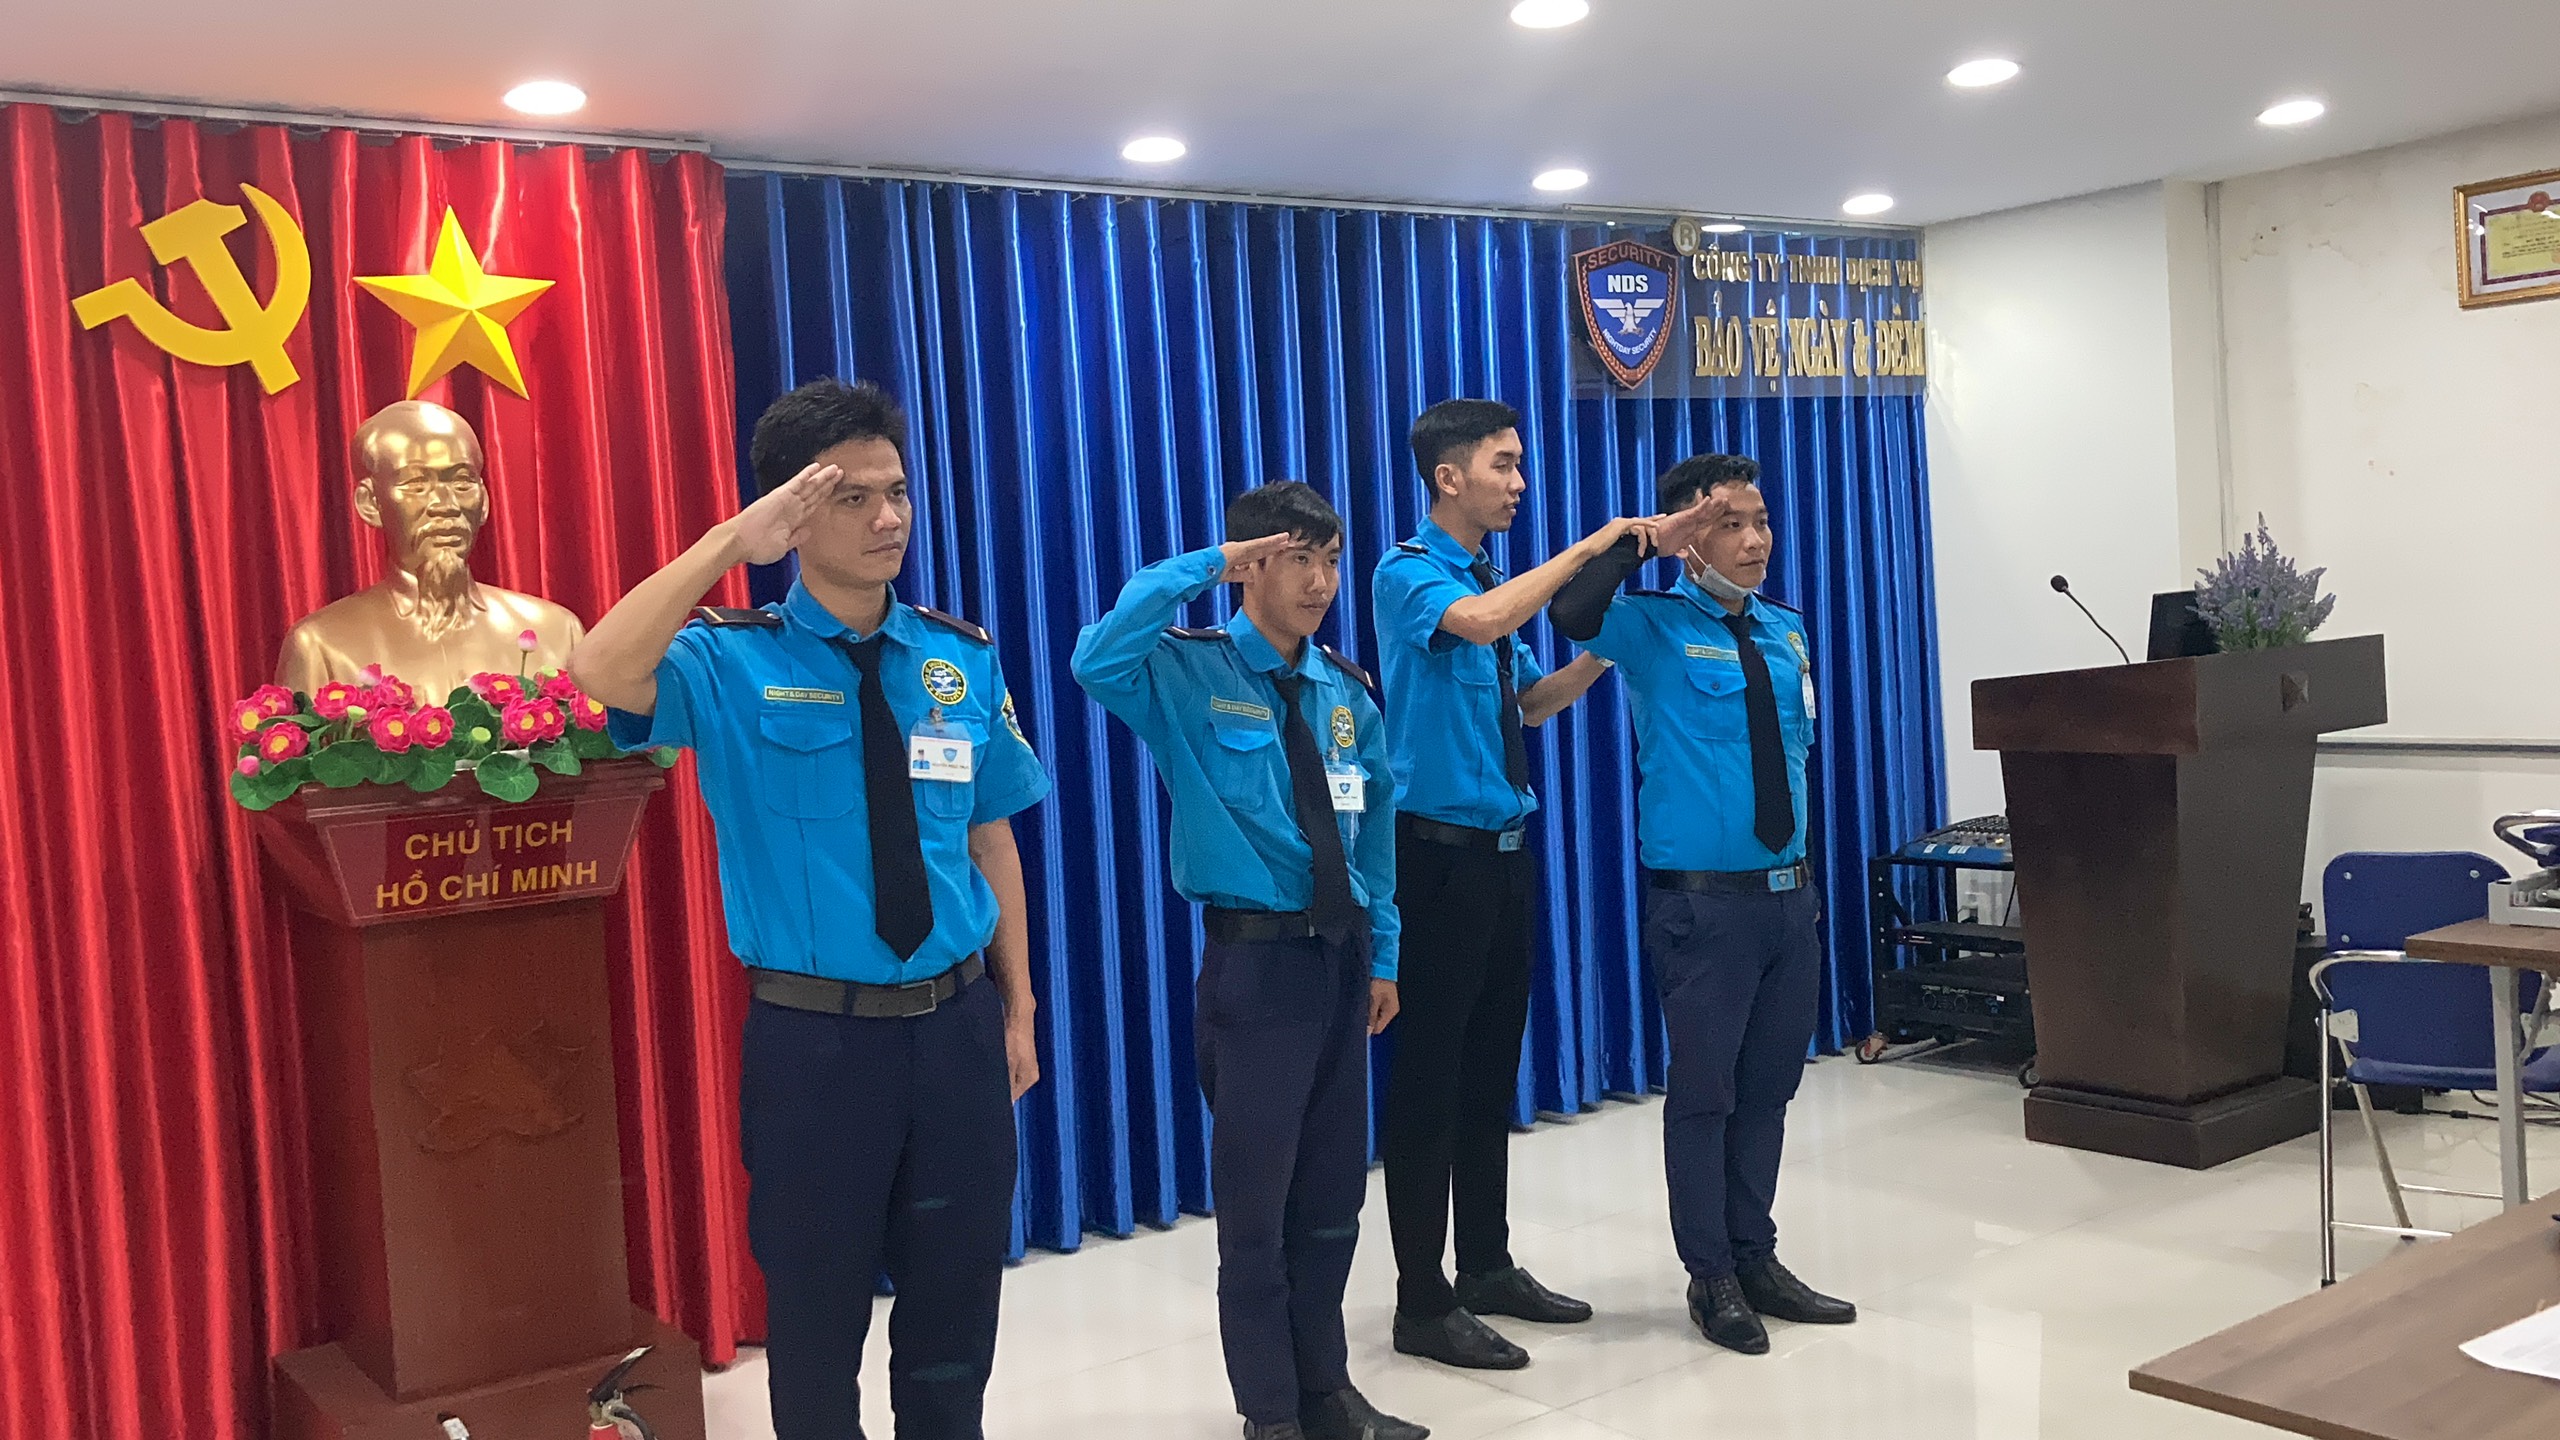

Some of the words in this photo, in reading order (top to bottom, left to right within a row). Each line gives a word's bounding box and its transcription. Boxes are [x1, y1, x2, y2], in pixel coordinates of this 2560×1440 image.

[1588, 245, 1662, 269] SECURITY
[1693, 242, 1749, 282] CÔNG
[1755, 253, 1781, 283] TY
[1787, 255, 1841, 284] TNHH
[1846, 258, 1892, 293] DỊCH
[1607, 274, 1649, 293] NDS
[1632, 326, 1657, 355] SECURITY
[1694, 290, 1743, 377] BẢO
[1749, 299, 1781, 392] VỆ
[1787, 299, 1848, 377] NGÀY
[1852, 318, 1871, 377] &
[405, 819, 481, 860] CHỦ
[492, 819, 573, 854] TỊCH
[376, 869, 428, 909] HỒ
[439, 864, 502, 902] CHÍ
[511, 860, 598, 893] MINH
